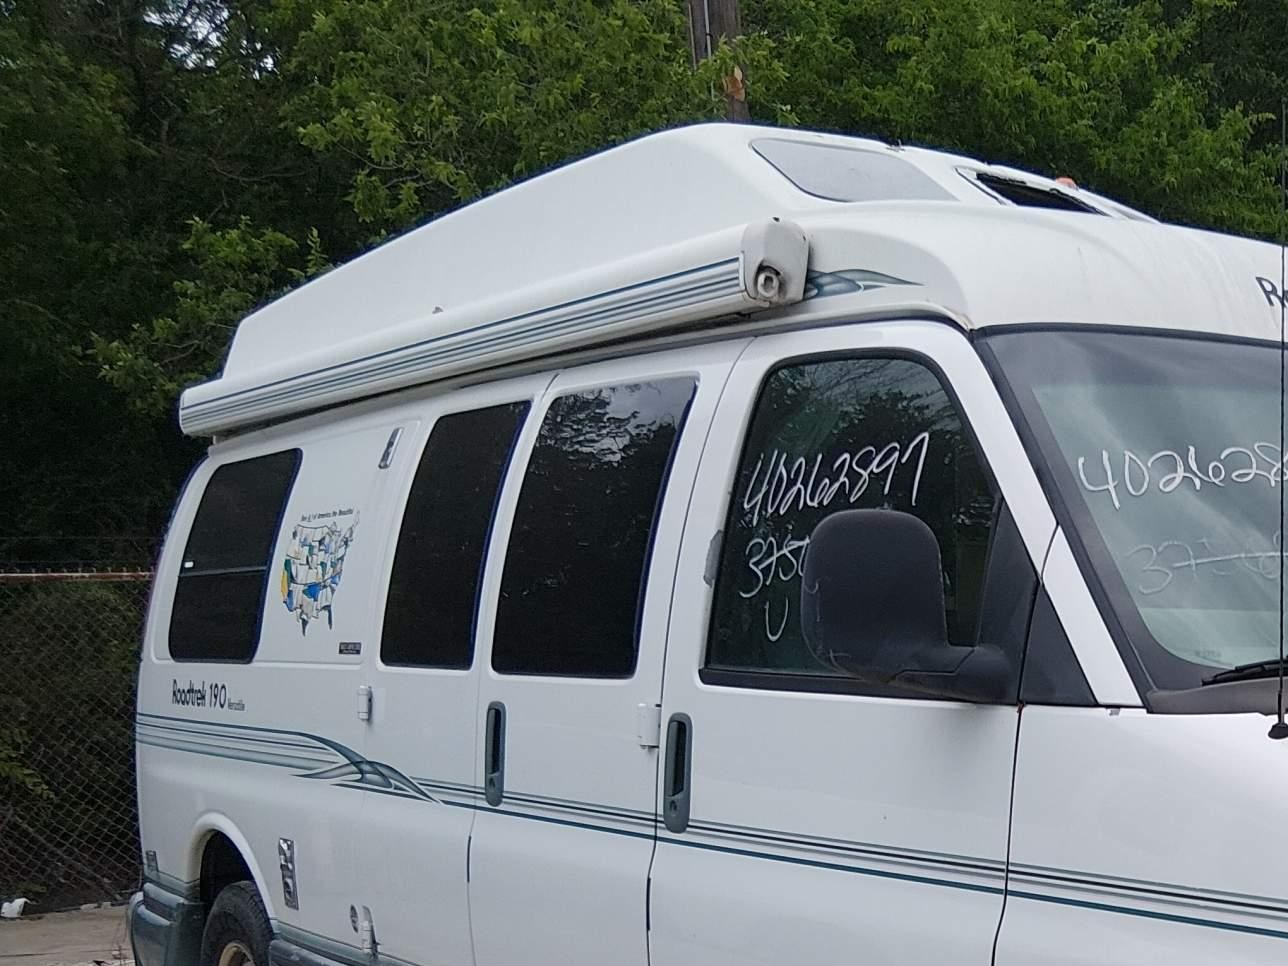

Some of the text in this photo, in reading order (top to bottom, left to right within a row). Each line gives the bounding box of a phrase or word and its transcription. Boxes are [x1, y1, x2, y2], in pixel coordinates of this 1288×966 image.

[743, 432, 929, 527] 40262897
[172, 678, 206, 707] Roadtrek
[209, 683, 227, 709] 190
